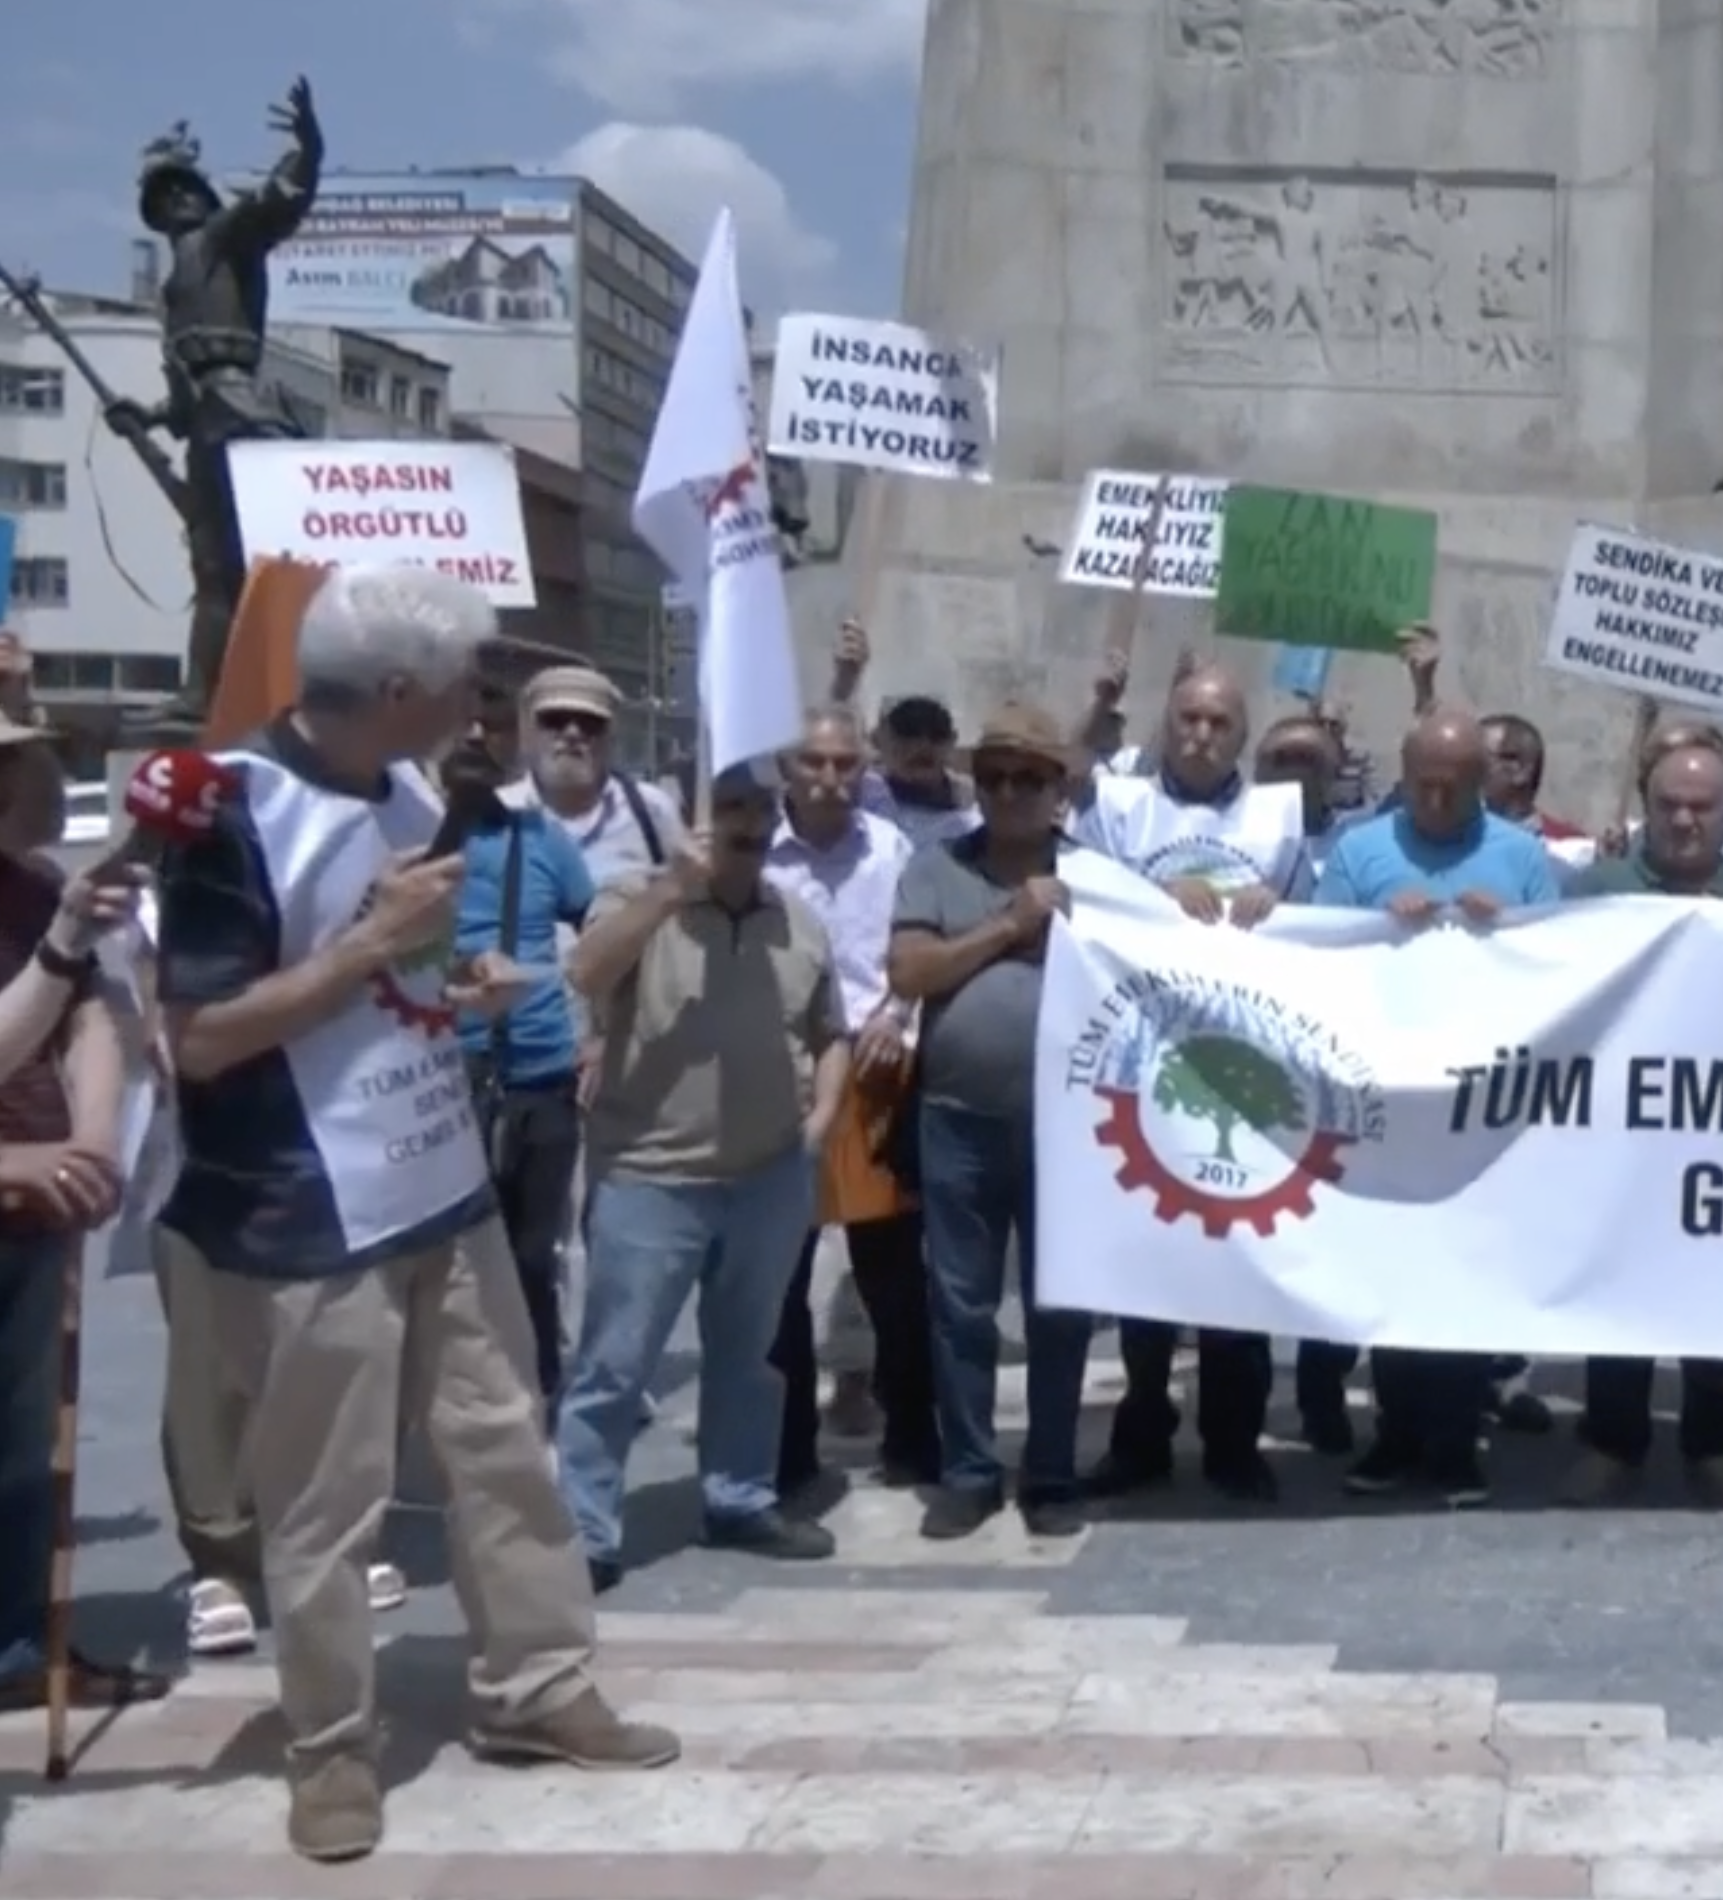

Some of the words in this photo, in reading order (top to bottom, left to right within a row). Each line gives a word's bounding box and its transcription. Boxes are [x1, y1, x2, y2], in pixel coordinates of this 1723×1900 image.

[801, 374, 970, 421] YAŞAMAK
[788, 411, 980, 467] İSTİYORUZ
[303, 464, 453, 497] YAŞASIN
[303, 505, 468, 539] ÖRGÜTLÜ
[1593, 540, 1693, 586] SENDİKA
[1574, 571, 1638, 605] TOPLU
[1594, 608, 1700, 655] HAKKIMIZ
[1445, 1045, 1595, 1133] TÜM
[1194, 1161, 1248, 1188] 2017
